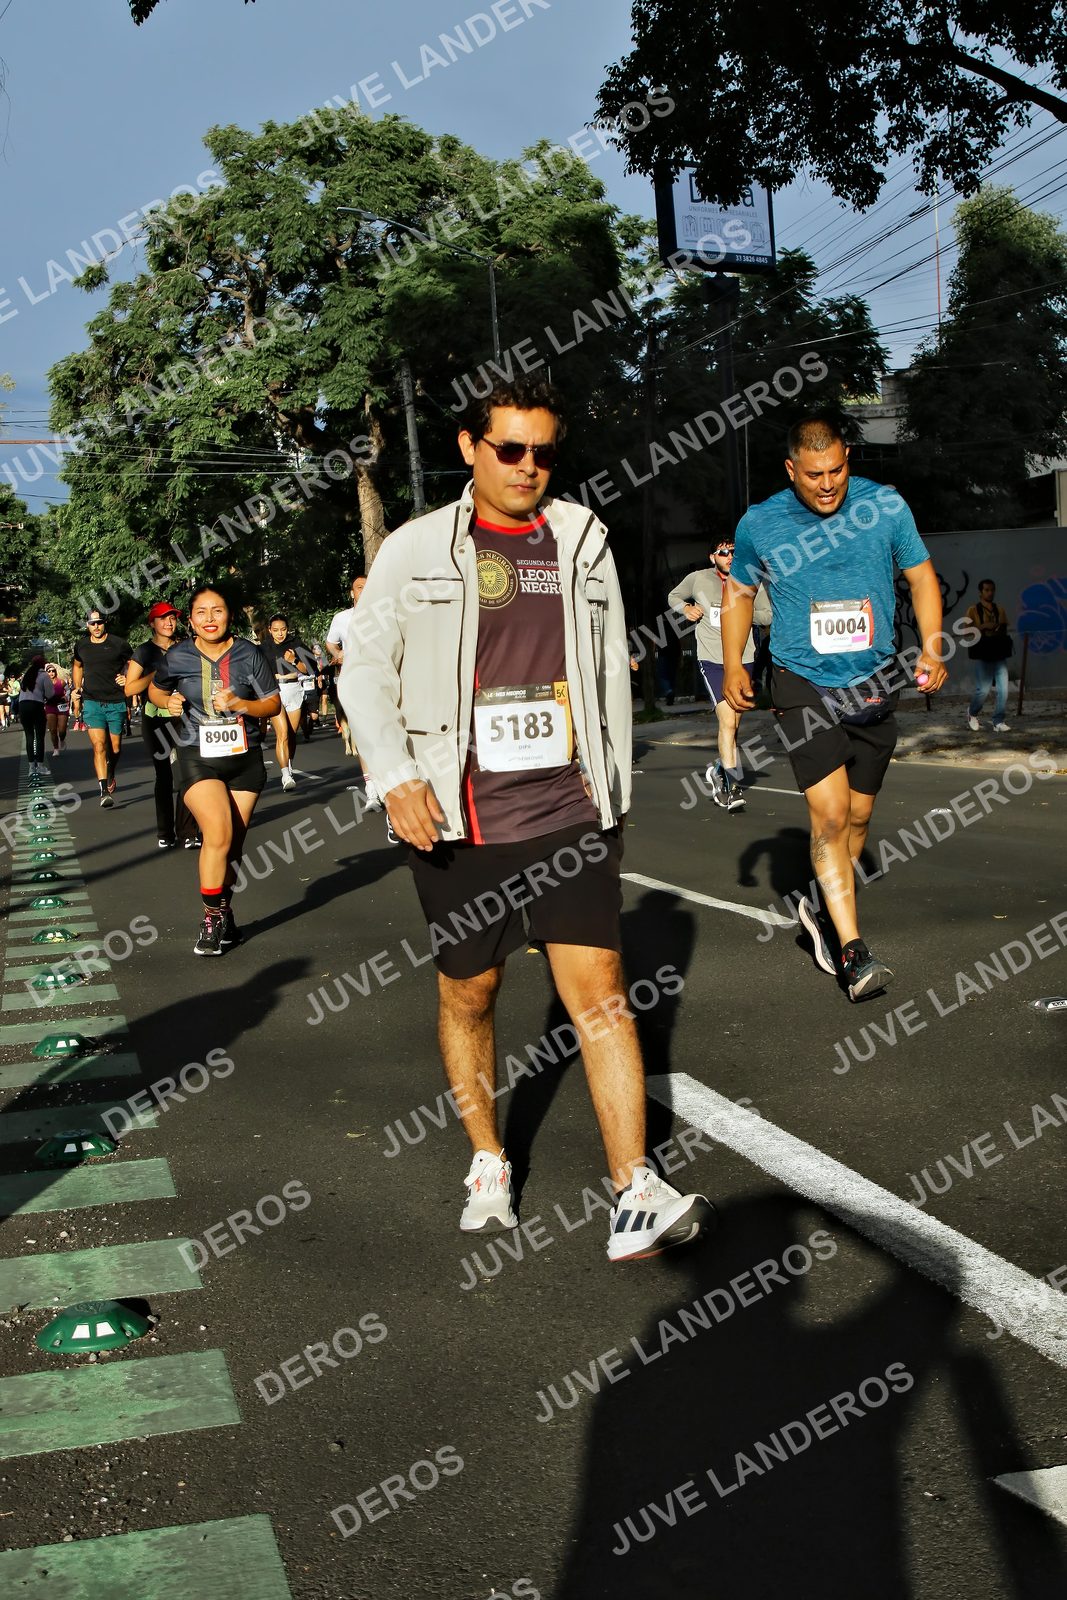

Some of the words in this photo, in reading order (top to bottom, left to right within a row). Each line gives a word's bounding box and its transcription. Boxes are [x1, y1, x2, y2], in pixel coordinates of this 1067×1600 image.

[736, 254, 742, 262] 33
[486, 552, 514, 574] NEGROS
[814, 616, 866, 636] 10004
[206, 730, 238, 744] 8900
[490, 712, 554, 742] 5183
